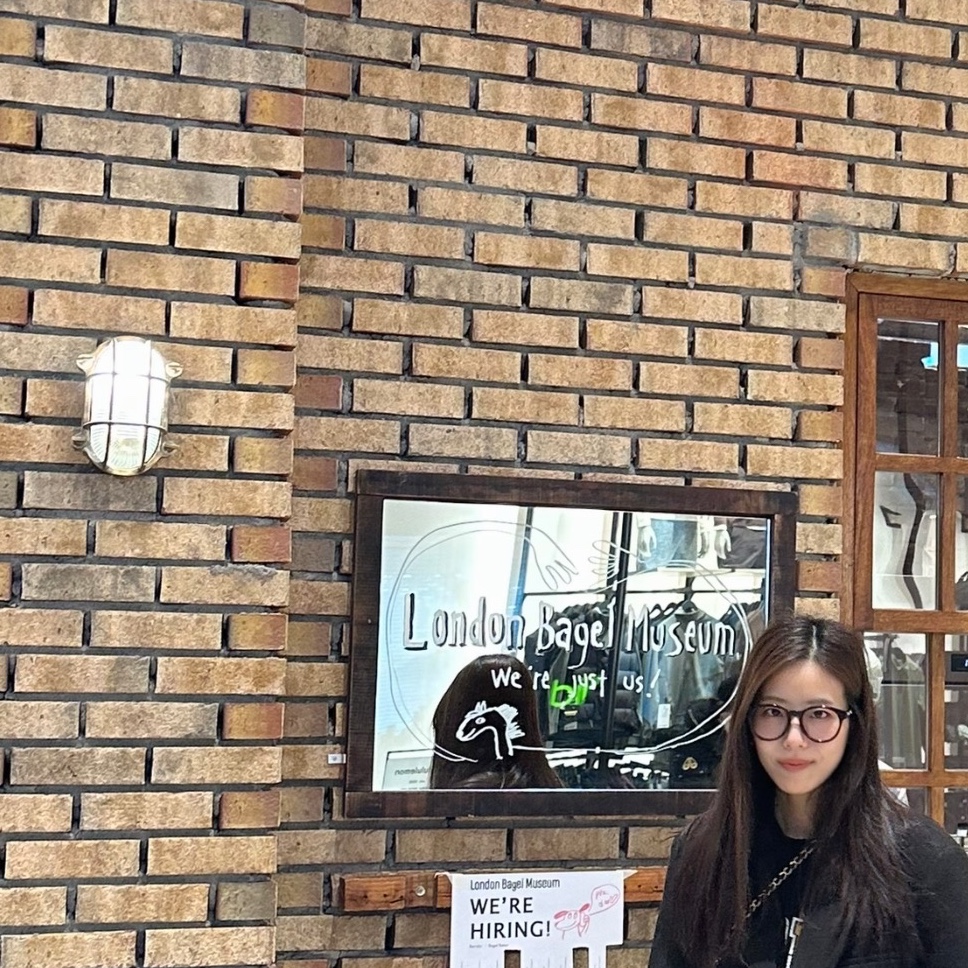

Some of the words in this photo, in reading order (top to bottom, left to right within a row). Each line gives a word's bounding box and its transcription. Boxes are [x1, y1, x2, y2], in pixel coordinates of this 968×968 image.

[403, 592, 527, 650] London
[534, 597, 617, 669] Bagel
[561, 669, 608, 709] just
[622, 667, 661, 698] us!
[470, 879, 500, 891] London
[501, 878, 524, 892] Bagel
[525, 877, 560, 889] Museum
[470, 897, 534, 915] WE'RE
[470, 920, 550, 940] HIRING!
